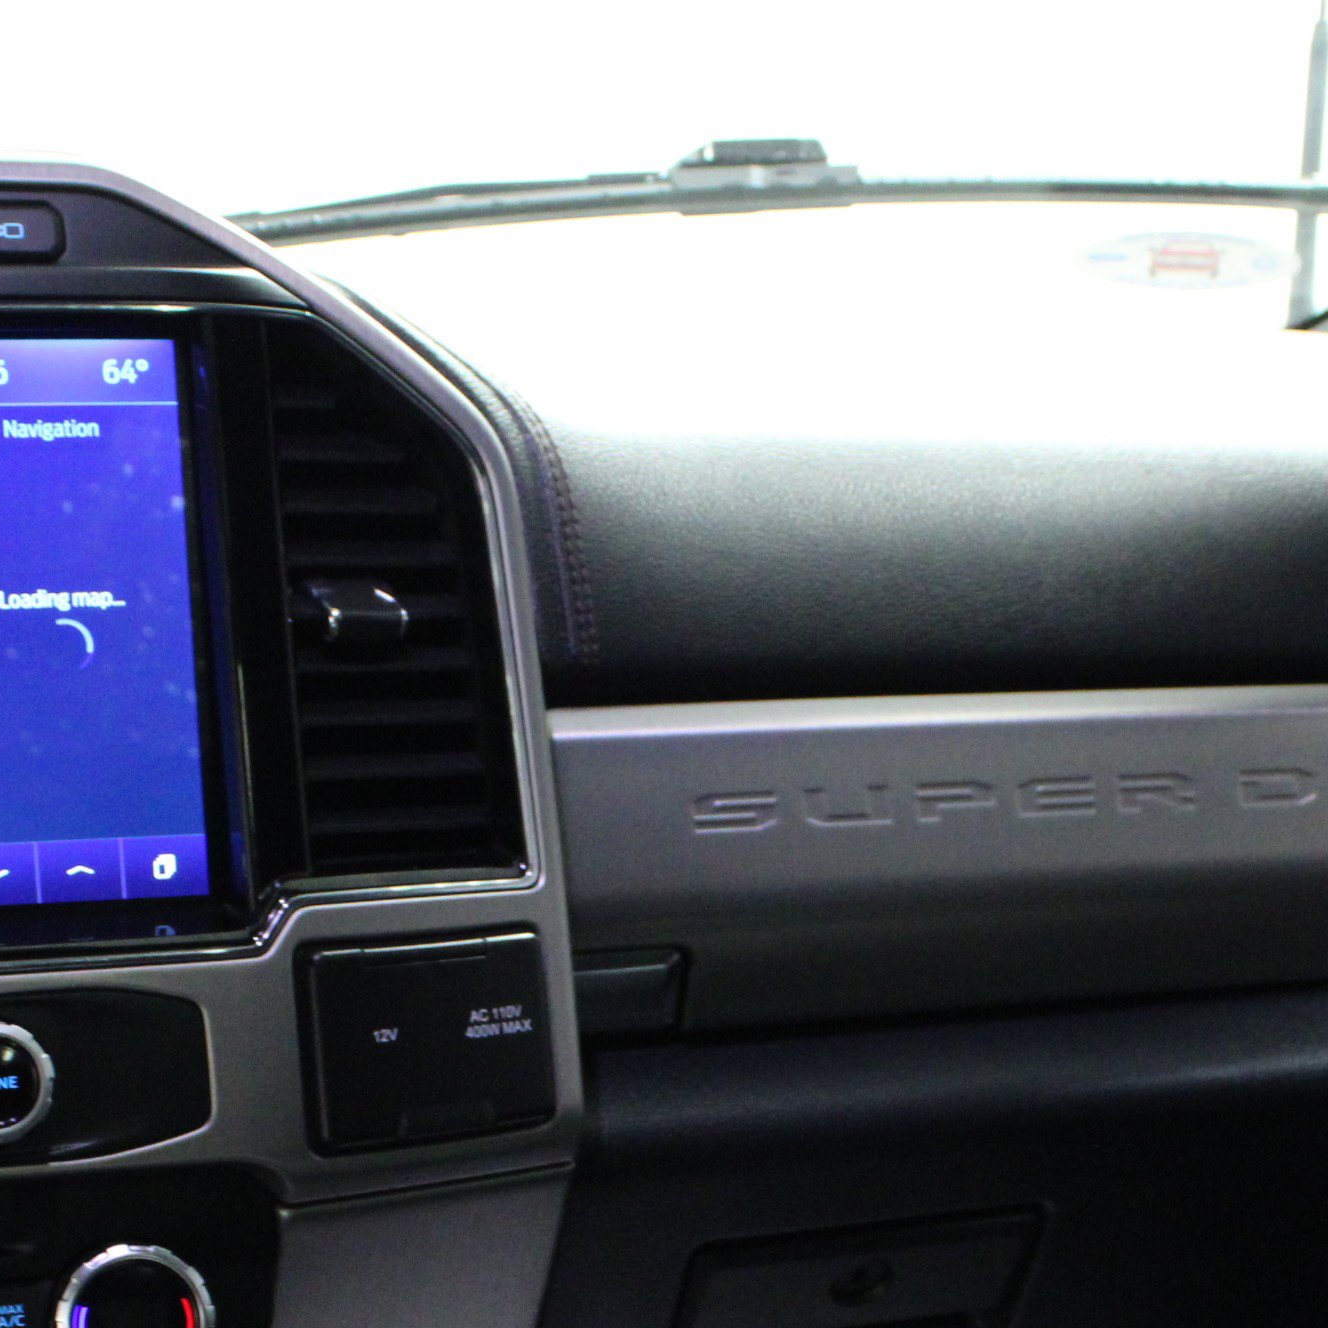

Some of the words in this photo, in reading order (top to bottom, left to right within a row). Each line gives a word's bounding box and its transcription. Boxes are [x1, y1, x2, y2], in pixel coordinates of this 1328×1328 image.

[102, 358, 149, 384] 64°
[2, 420, 100, 441] Navigation
[693, 772, 1198, 833] SUPER
[469, 1008, 489, 1022] AC
[502, 1018, 532, 1034] MAX
[373, 1028, 399, 1043] 12V
